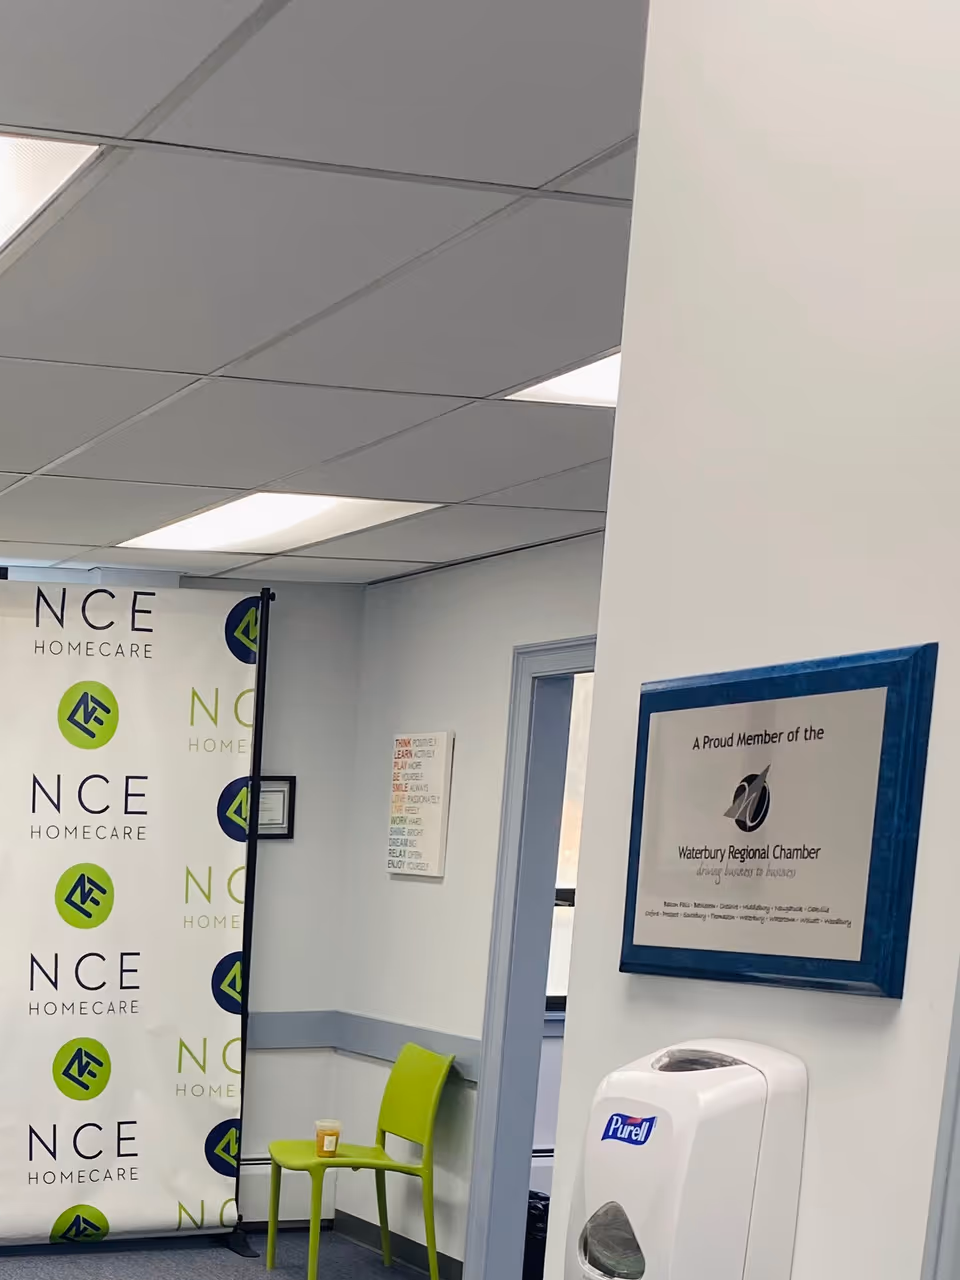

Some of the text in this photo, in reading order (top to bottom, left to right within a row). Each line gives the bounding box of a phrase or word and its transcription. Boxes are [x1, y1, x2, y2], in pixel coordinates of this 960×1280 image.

[36, 588, 155, 632] NCE
[35, 641, 152, 658] HOMECARE
[395, 739, 412, 748] THINK
[693, 725, 824, 750] A Proud Member of the
[189, 738, 247, 753] HOME
[394, 750, 412, 759] LEARN
[394, 761, 407, 770] PLAY
[393, 773, 400, 781] BE
[32, 774, 148, 814] NCE
[392, 783, 408, 792] SMILE
[391, 817, 407, 825] WORK
[31, 825, 145, 840] HOMECARE
[388, 849, 406, 858] RELAX
[678, 844, 821, 863] Waterbury Regional Chamber
[388, 860, 405, 869] ENJOY
[696, 862, 796, 884] driving business to business
[184, 915, 240, 928] HOME
[30, 953, 140, 991] NCE
[29, 1000, 138, 1015] HOMECARE
[176, 1084, 235, 1097] HOME
[609, 1114, 648, 1143] Purell
[29, 1121, 138, 1161] NCE
[29, 1167, 138, 1184] HOMECARE
